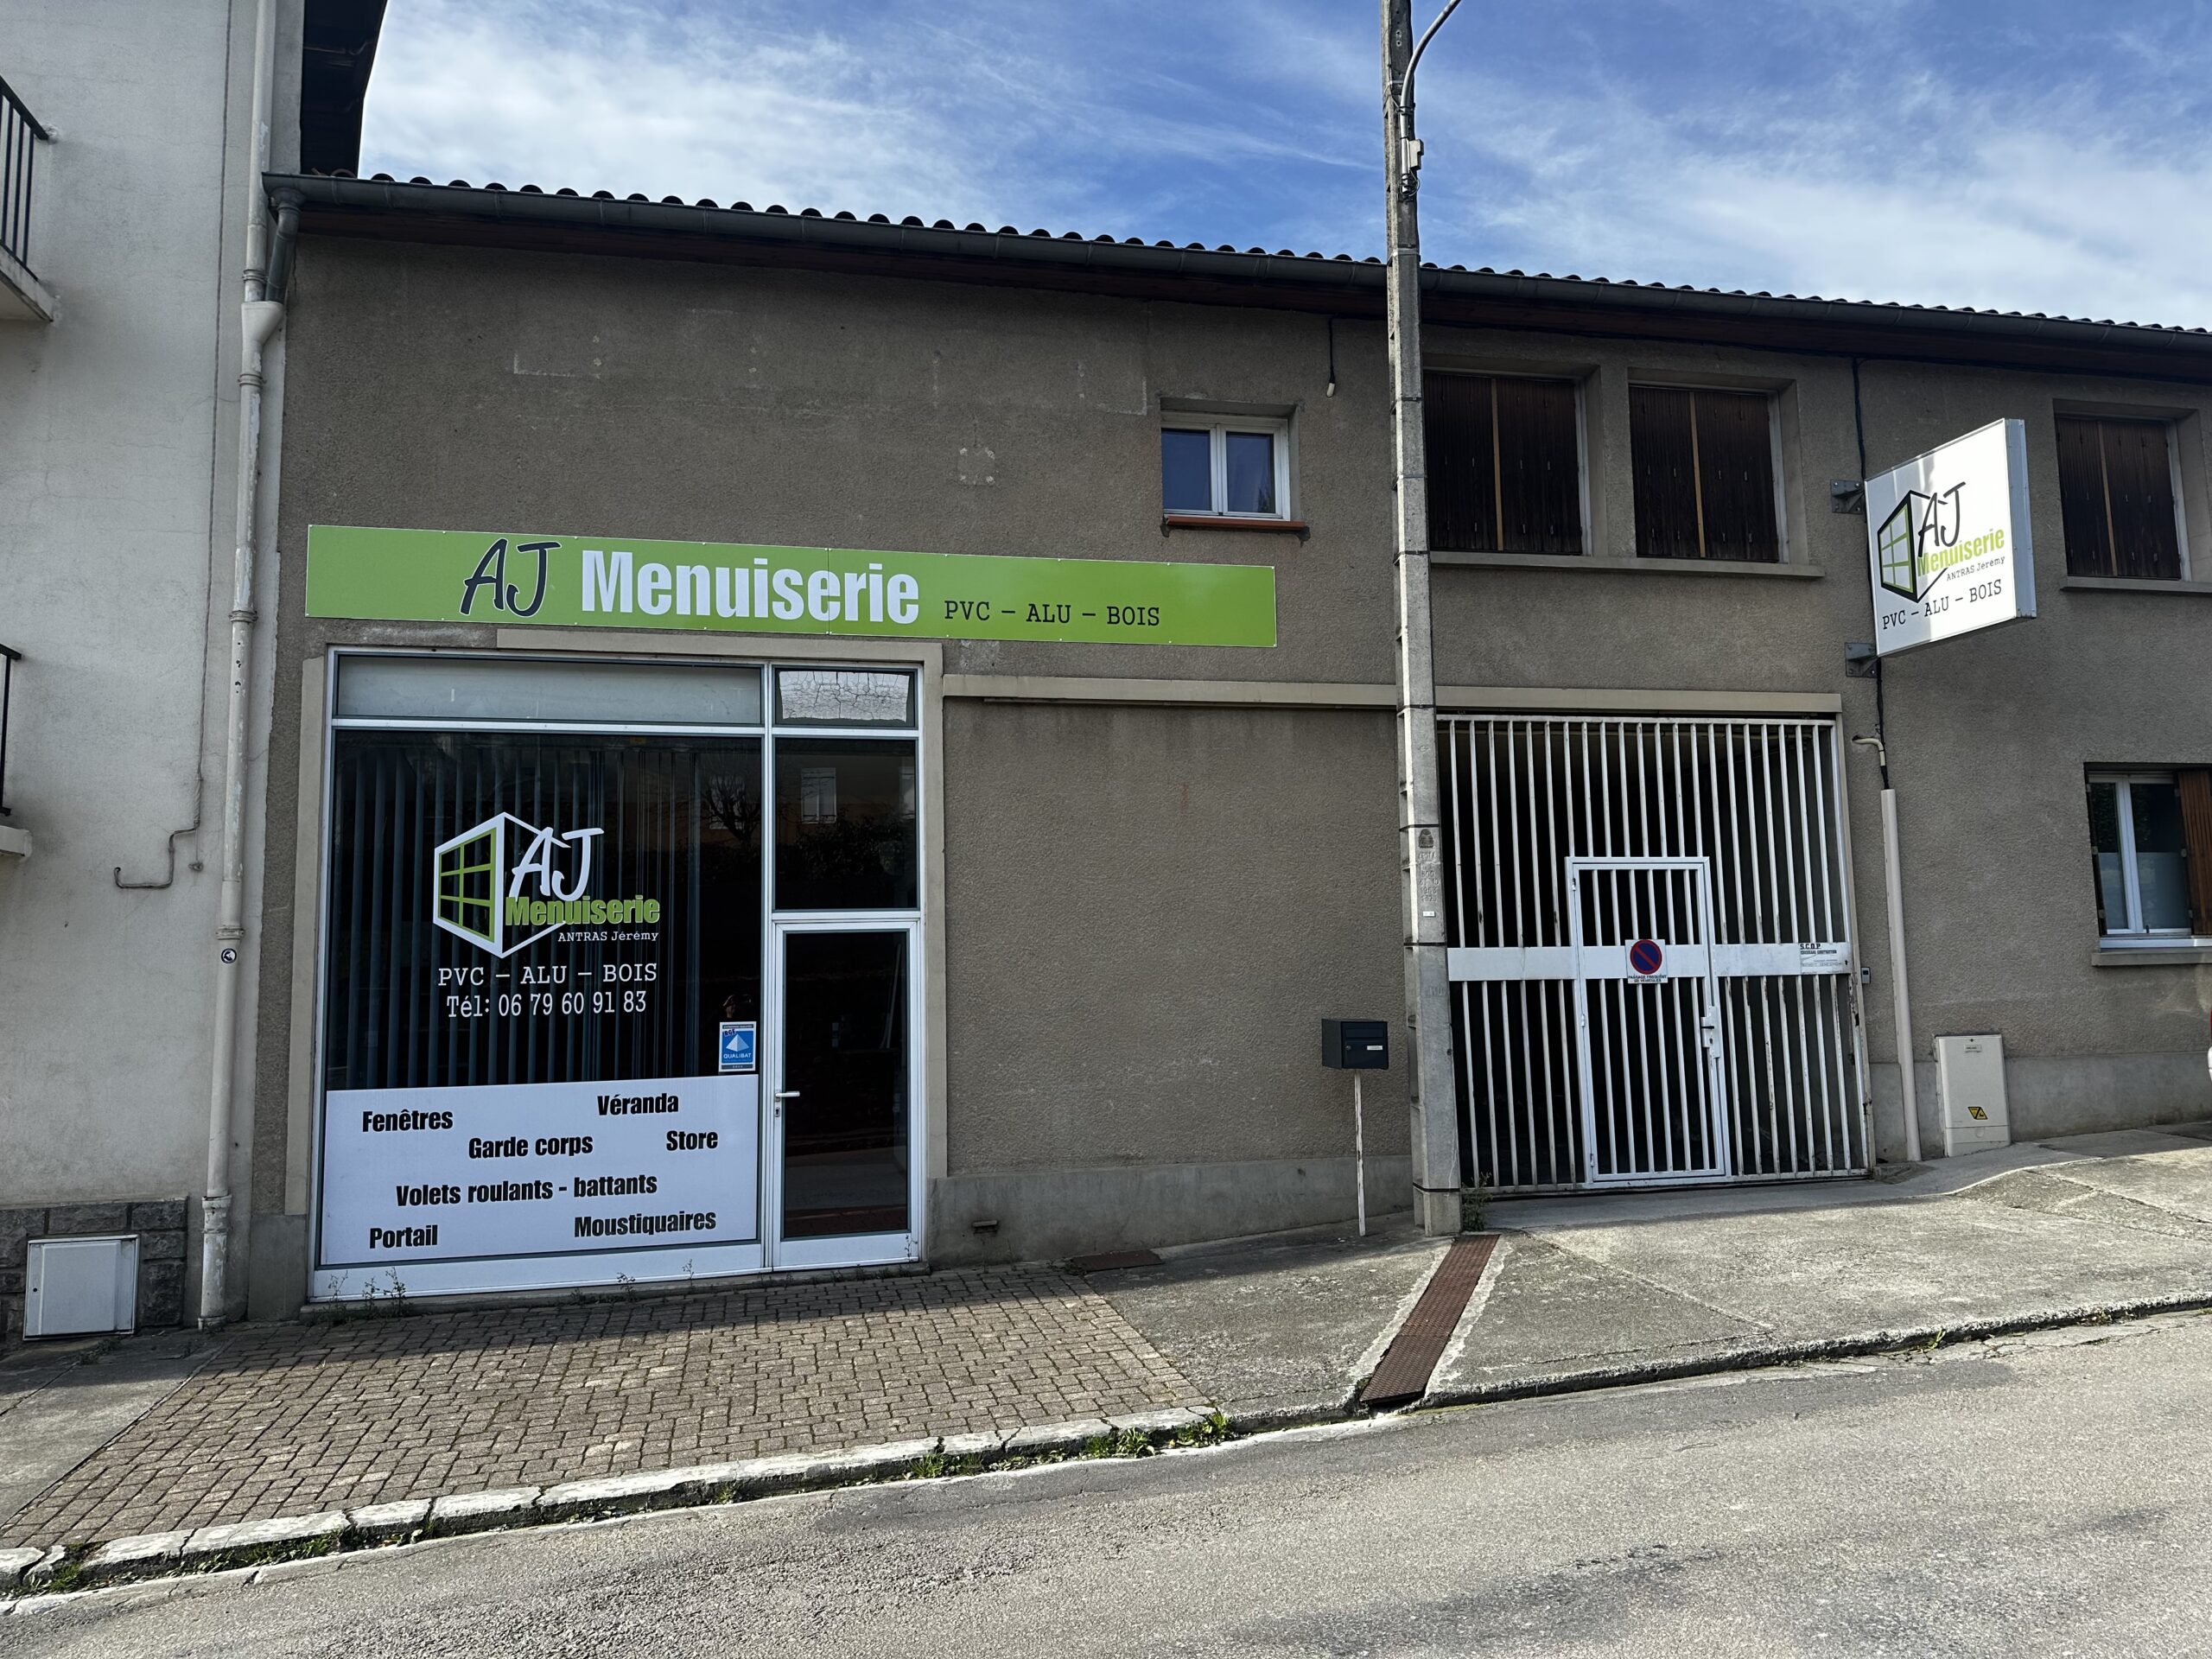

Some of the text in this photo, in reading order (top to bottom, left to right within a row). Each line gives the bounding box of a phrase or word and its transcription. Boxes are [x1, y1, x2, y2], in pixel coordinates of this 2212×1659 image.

[1917, 481, 1966, 557] AJ
[1917, 529, 2005, 576] Menuiserie
[460, 538, 919, 624] AJ Menuiserie
[1946, 565, 1975, 582] ANTRAS
[944, 601, 990, 620] PVC
[1026, 603, 1071, 623] ALU
[1107, 606, 1160, 626] BOIS
[1883, 610, 1906, 630] PVC
[1924, 596, 1949, 617] ALU
[1969, 579, 2002, 603] BOIS
[508, 827, 605, 902] AJ
[505, 894, 660, 926] Menuiserie
[557, 931, 659, 942] ANTRAS Jérémy
[438, 968, 484, 986] PVC
[520, 965, 567, 984] ALU
[603, 963, 658, 982] BOIS
[447, 990, 646, 1018] Tél: 06 79 60 91 83
[597, 1093, 679, 1116] Véranda
[362, 1109, 454, 1132] Fenêtres
[468, 1135, 593, 1159] Garde corps
[666, 1130, 718, 1151] Store
[396, 1183, 461, 1206] Volets
[467, 1179, 553, 1203] roulants
[574, 1173, 658, 1198] battants
[369, 1224, 438, 1249] Portail
[574, 1211, 716, 1237] Moustiquaires
